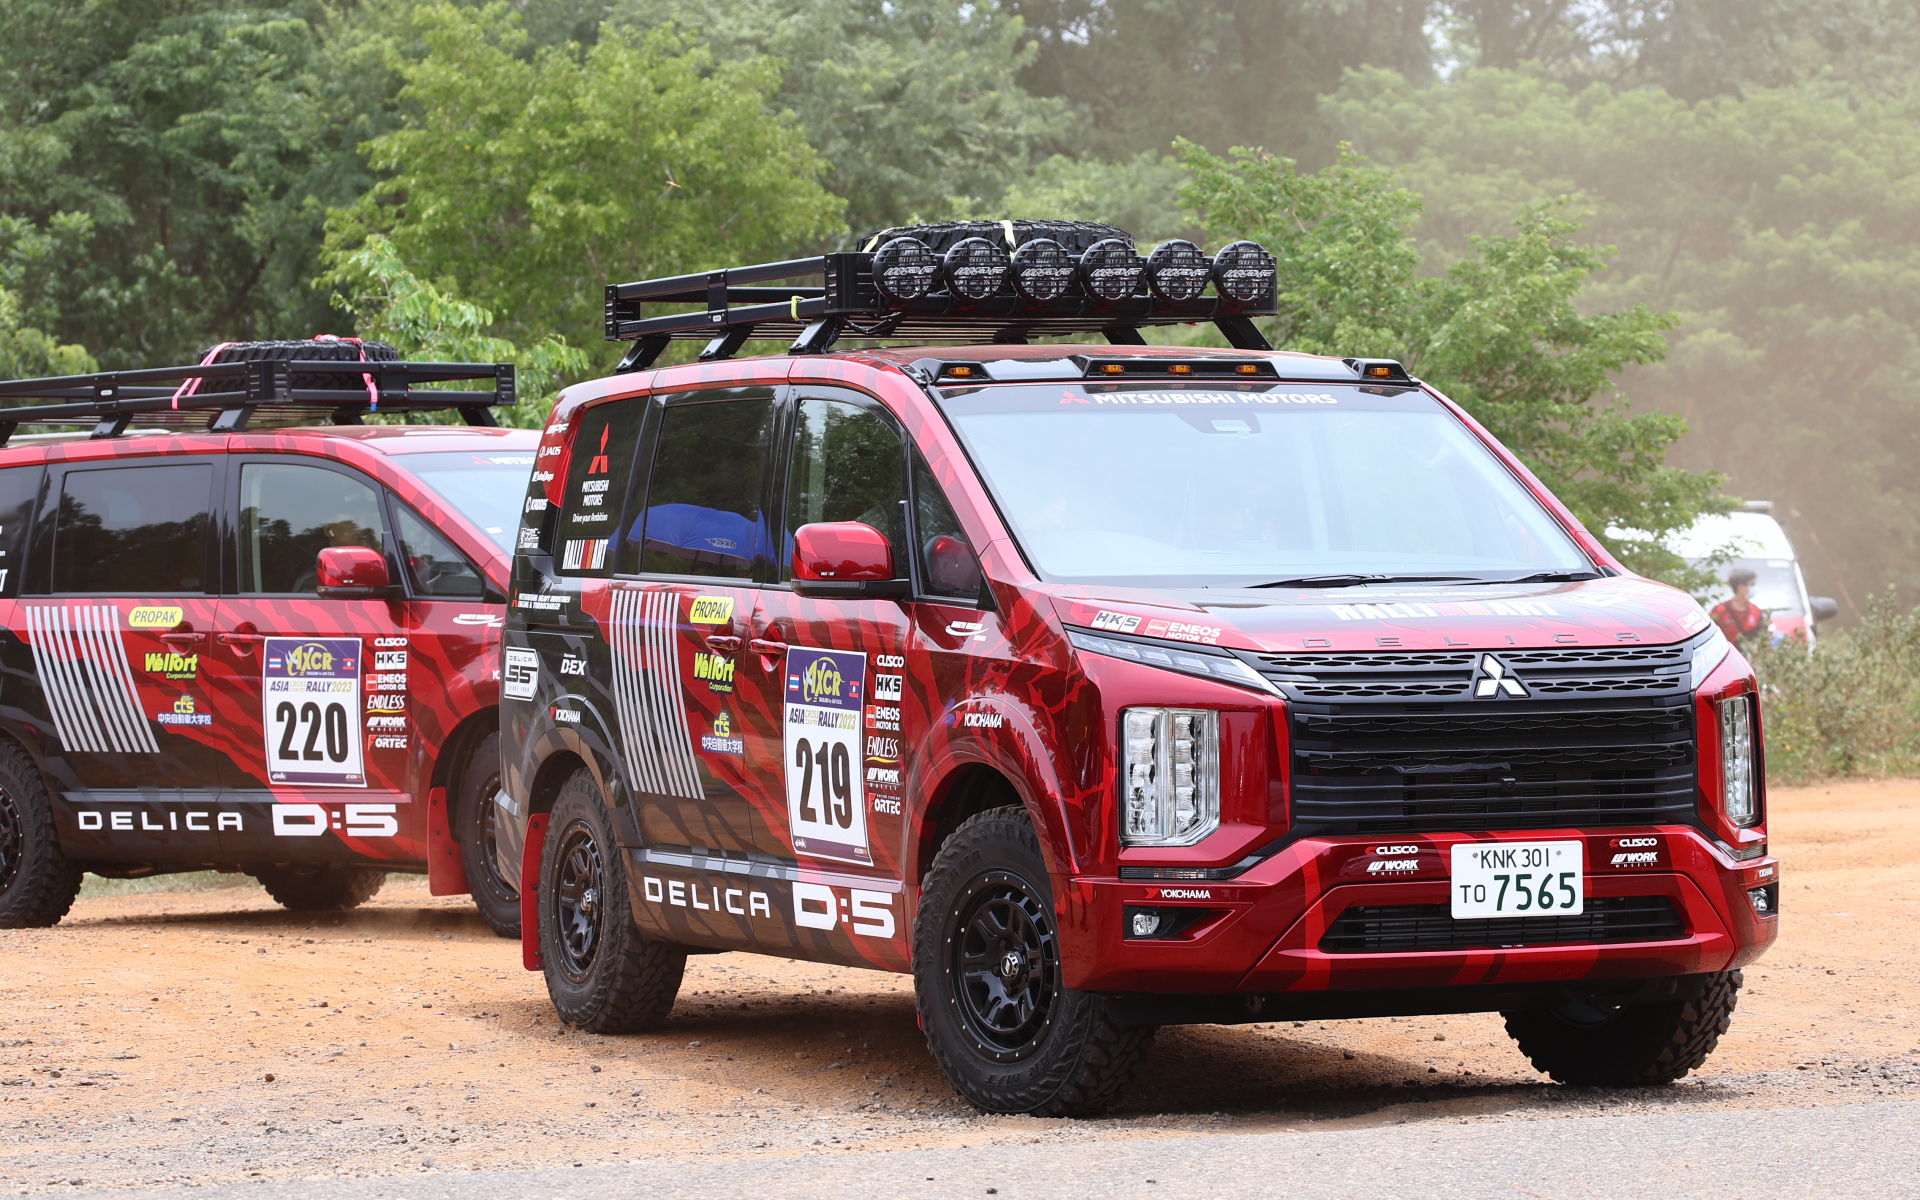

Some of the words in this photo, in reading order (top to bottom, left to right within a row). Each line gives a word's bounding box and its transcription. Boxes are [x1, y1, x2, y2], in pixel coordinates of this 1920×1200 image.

[1092, 393, 1236, 405] MITSUBISHI
[1236, 393, 1339, 404] MOTORS
[581, 479, 610, 493] MITSUBISHI
[582, 494, 604, 507] MOTORS
[572, 513, 583, 523] Drive
[581, 515, 591, 525] your
[590, 512, 608, 521] Ambition
[133, 610, 178, 623] PROPAK
[693, 600, 731, 619] PROPAK
[1095, 612, 1140, 627] HKS
[1168, 622, 1222, 637] ENEOS
[374, 637, 408, 647] CUSCO
[1166, 631, 1200, 643] MOTOR
[1202, 636, 1217, 644] OIL
[1302, 632, 1641, 648] DELICA
[376, 652, 406, 664] HKS
[509, 655, 533, 663] DELICA
[877, 654, 904, 668] CUSCO
[166, 672, 196, 680] Corporation
[377, 673, 407, 683] ENEOS
[270, 680, 289, 692] ASIA
[305, 681, 332, 692] RALLY
[331, 681, 353, 693] 2023
[709, 682, 733, 693] Corporation
[876, 674, 902, 693] HKS
[367, 694, 406, 710] ENDLESS
[157, 713, 212, 725] 中央自動車大学校
[555, 708, 581, 723] YOKOHAMA
[789, 707, 805, 725] ASIA
[818, 709, 840, 729] RALLY
[838, 712, 857, 730] 2023
[876, 706, 901, 721] ENEOS
[964, 712, 1003, 729] YOKOHAMA
[379, 716, 406, 727] WORK
[876, 720, 892, 730] MOTOR
[276, 701, 349, 763] 220
[701, 736, 743, 754] 中央自動車大学校
[866, 735, 899, 758] ENDLESS
[877, 767, 900, 783] WORK
[796, 737, 853, 829] 219
[77, 811, 243, 831] DELICA
[271, 803, 398, 837] D:5
[1375, 845, 1419, 855] CUSCO
[1619, 838, 1658, 848] CUSCO
[1480, 849, 1517, 869] KNK
[1521, 848, 1549, 867] 301
[1627, 851, 1658, 862] WORK
[1384, 859, 1419, 870] WORK
[1160, 888, 1211, 899] YOKOHAMA
[1460, 884, 1486, 903] TO
[1493, 872, 1576, 911] 7565
[643, 876, 771, 919] DELICA
[792, 881, 896, 939] D:5
